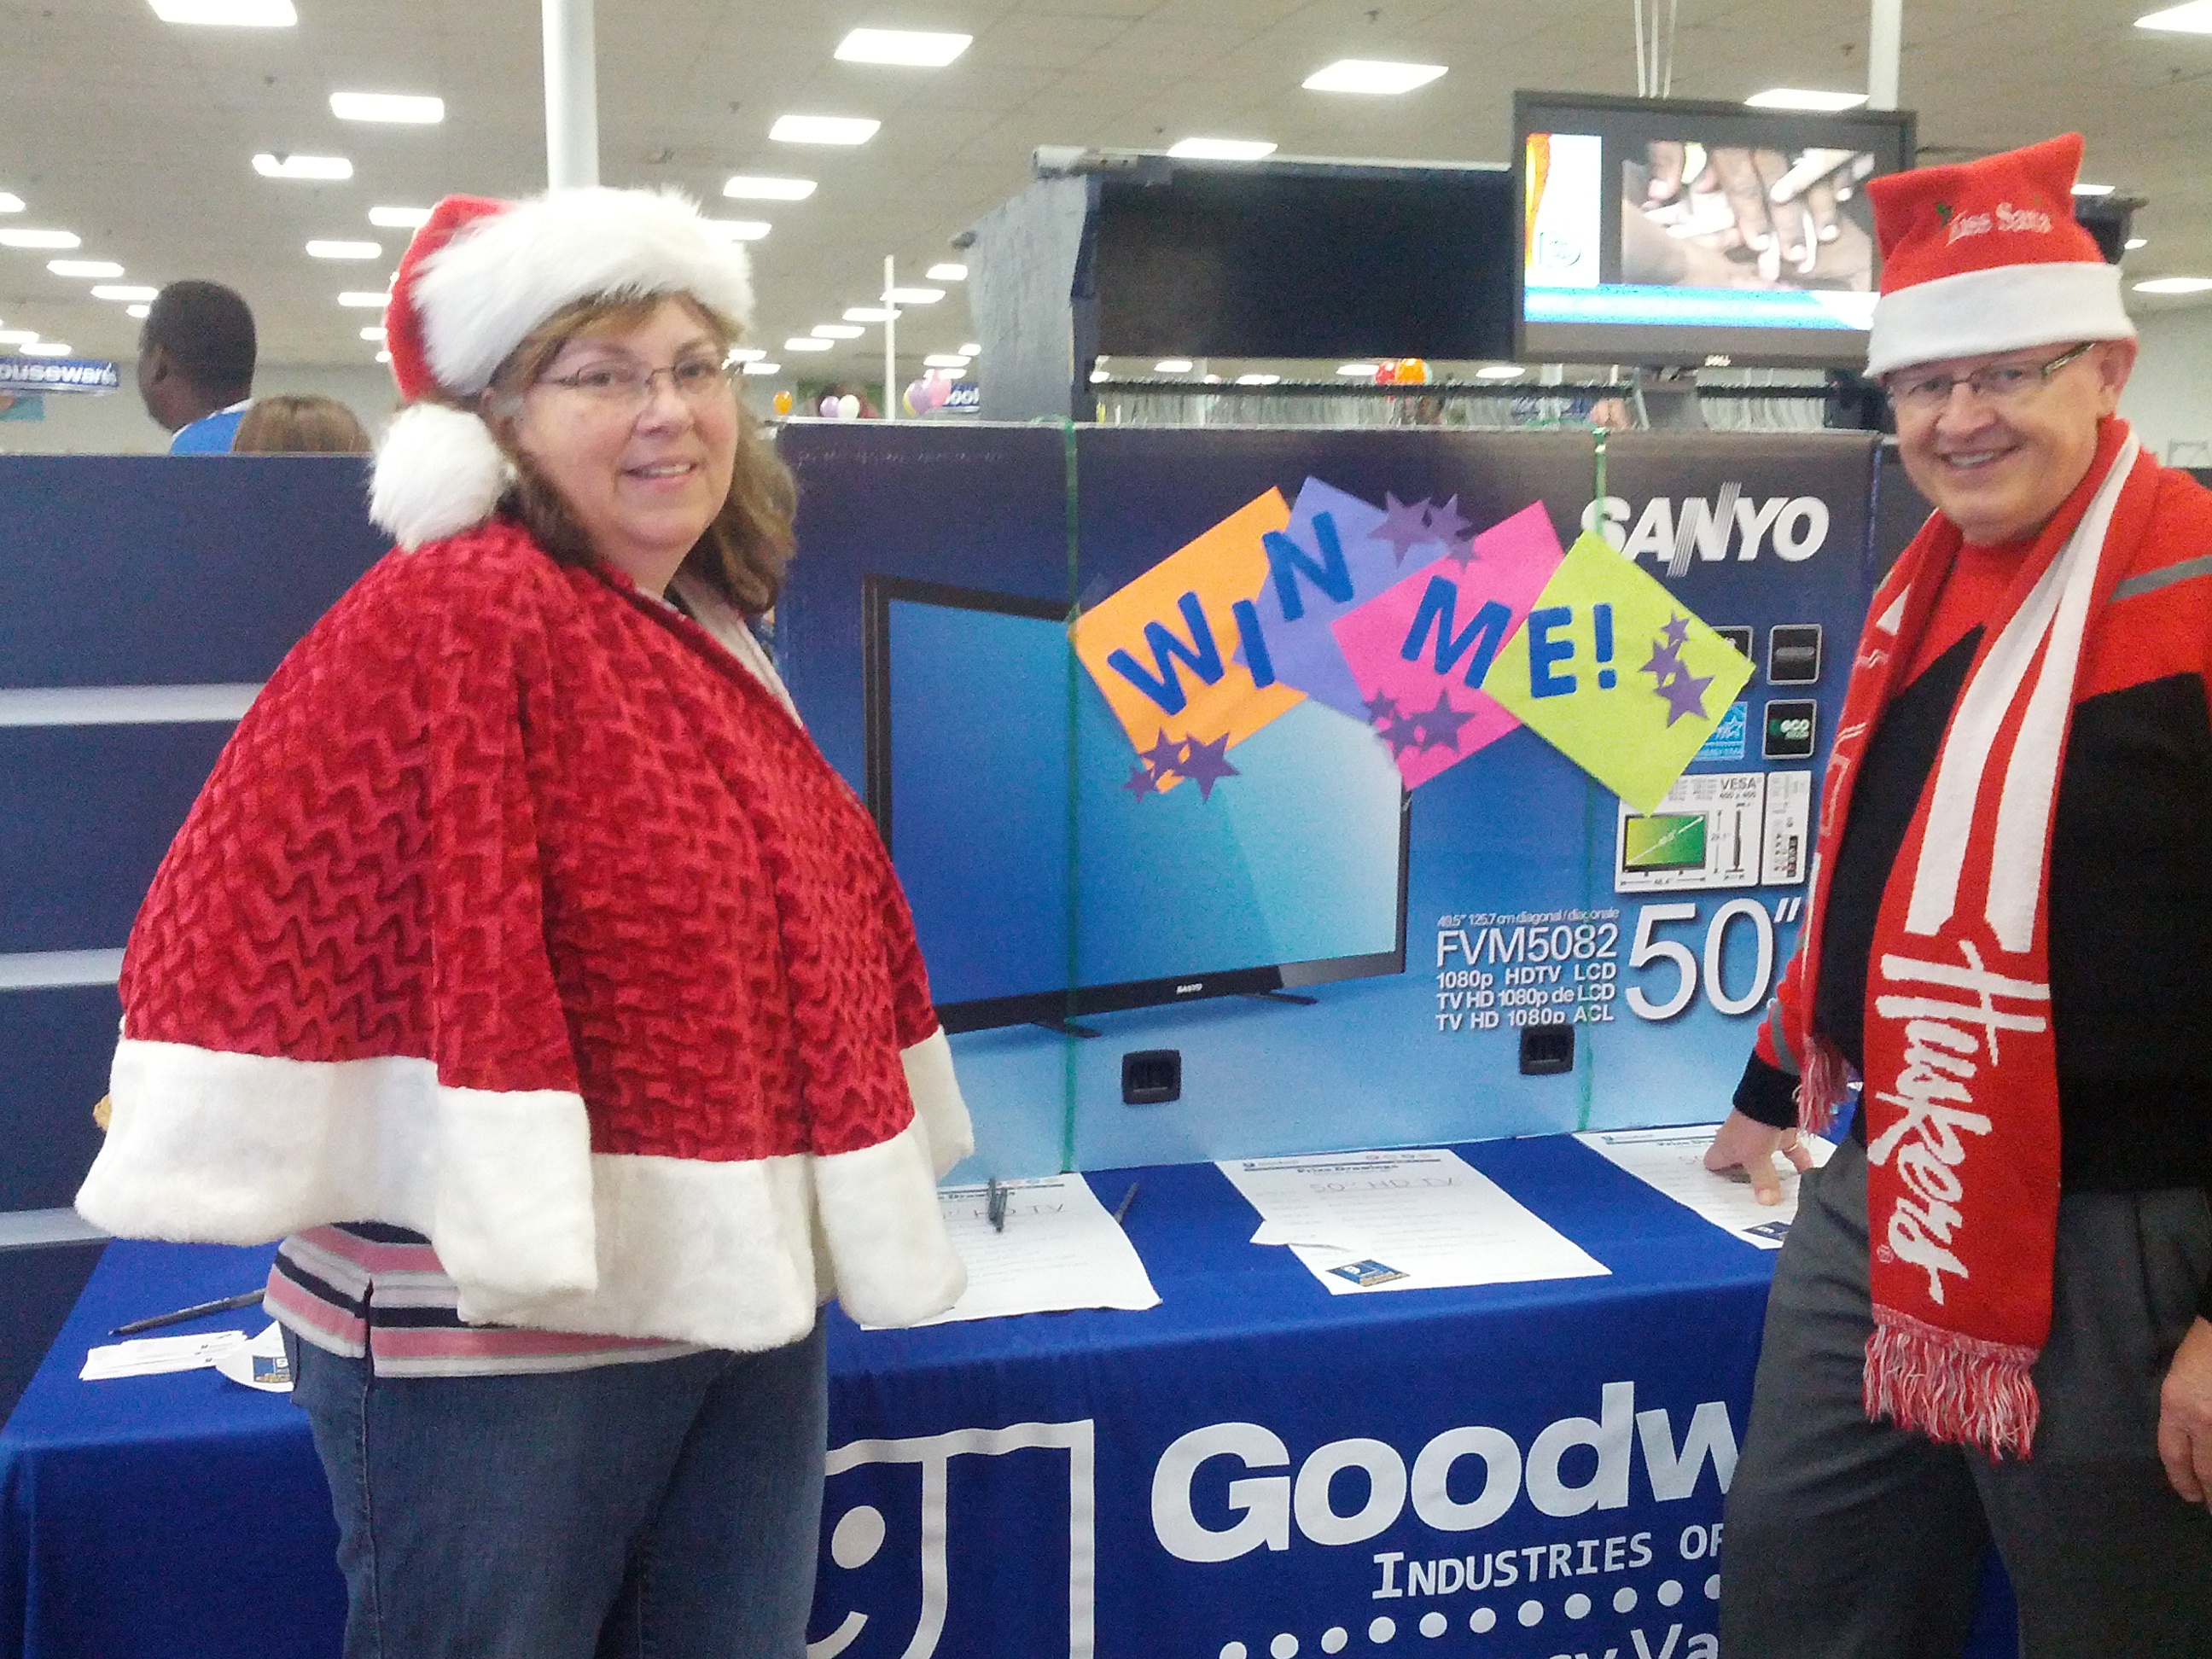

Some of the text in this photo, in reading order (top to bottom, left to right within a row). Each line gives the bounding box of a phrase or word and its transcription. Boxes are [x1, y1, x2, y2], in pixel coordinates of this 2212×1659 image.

[1580, 481, 1830, 578] SANYO
[1108, 511, 1617, 716] WIN ME!
[1436, 923, 1619, 967] FVM5082
[1435, 982, 1615, 1010] TV HD 1080p de LCD
[1436, 961, 1617, 990] 1080p HDTV LCD
[1435, 1012, 1463, 1031] TV
[1470, 1010, 1499, 1029] HD
[1574, 1004, 1615, 1023] ACL
[1150, 1380, 1739, 1563] Goodw
[1371, 1532, 1653, 1600] INDUSTRIES
